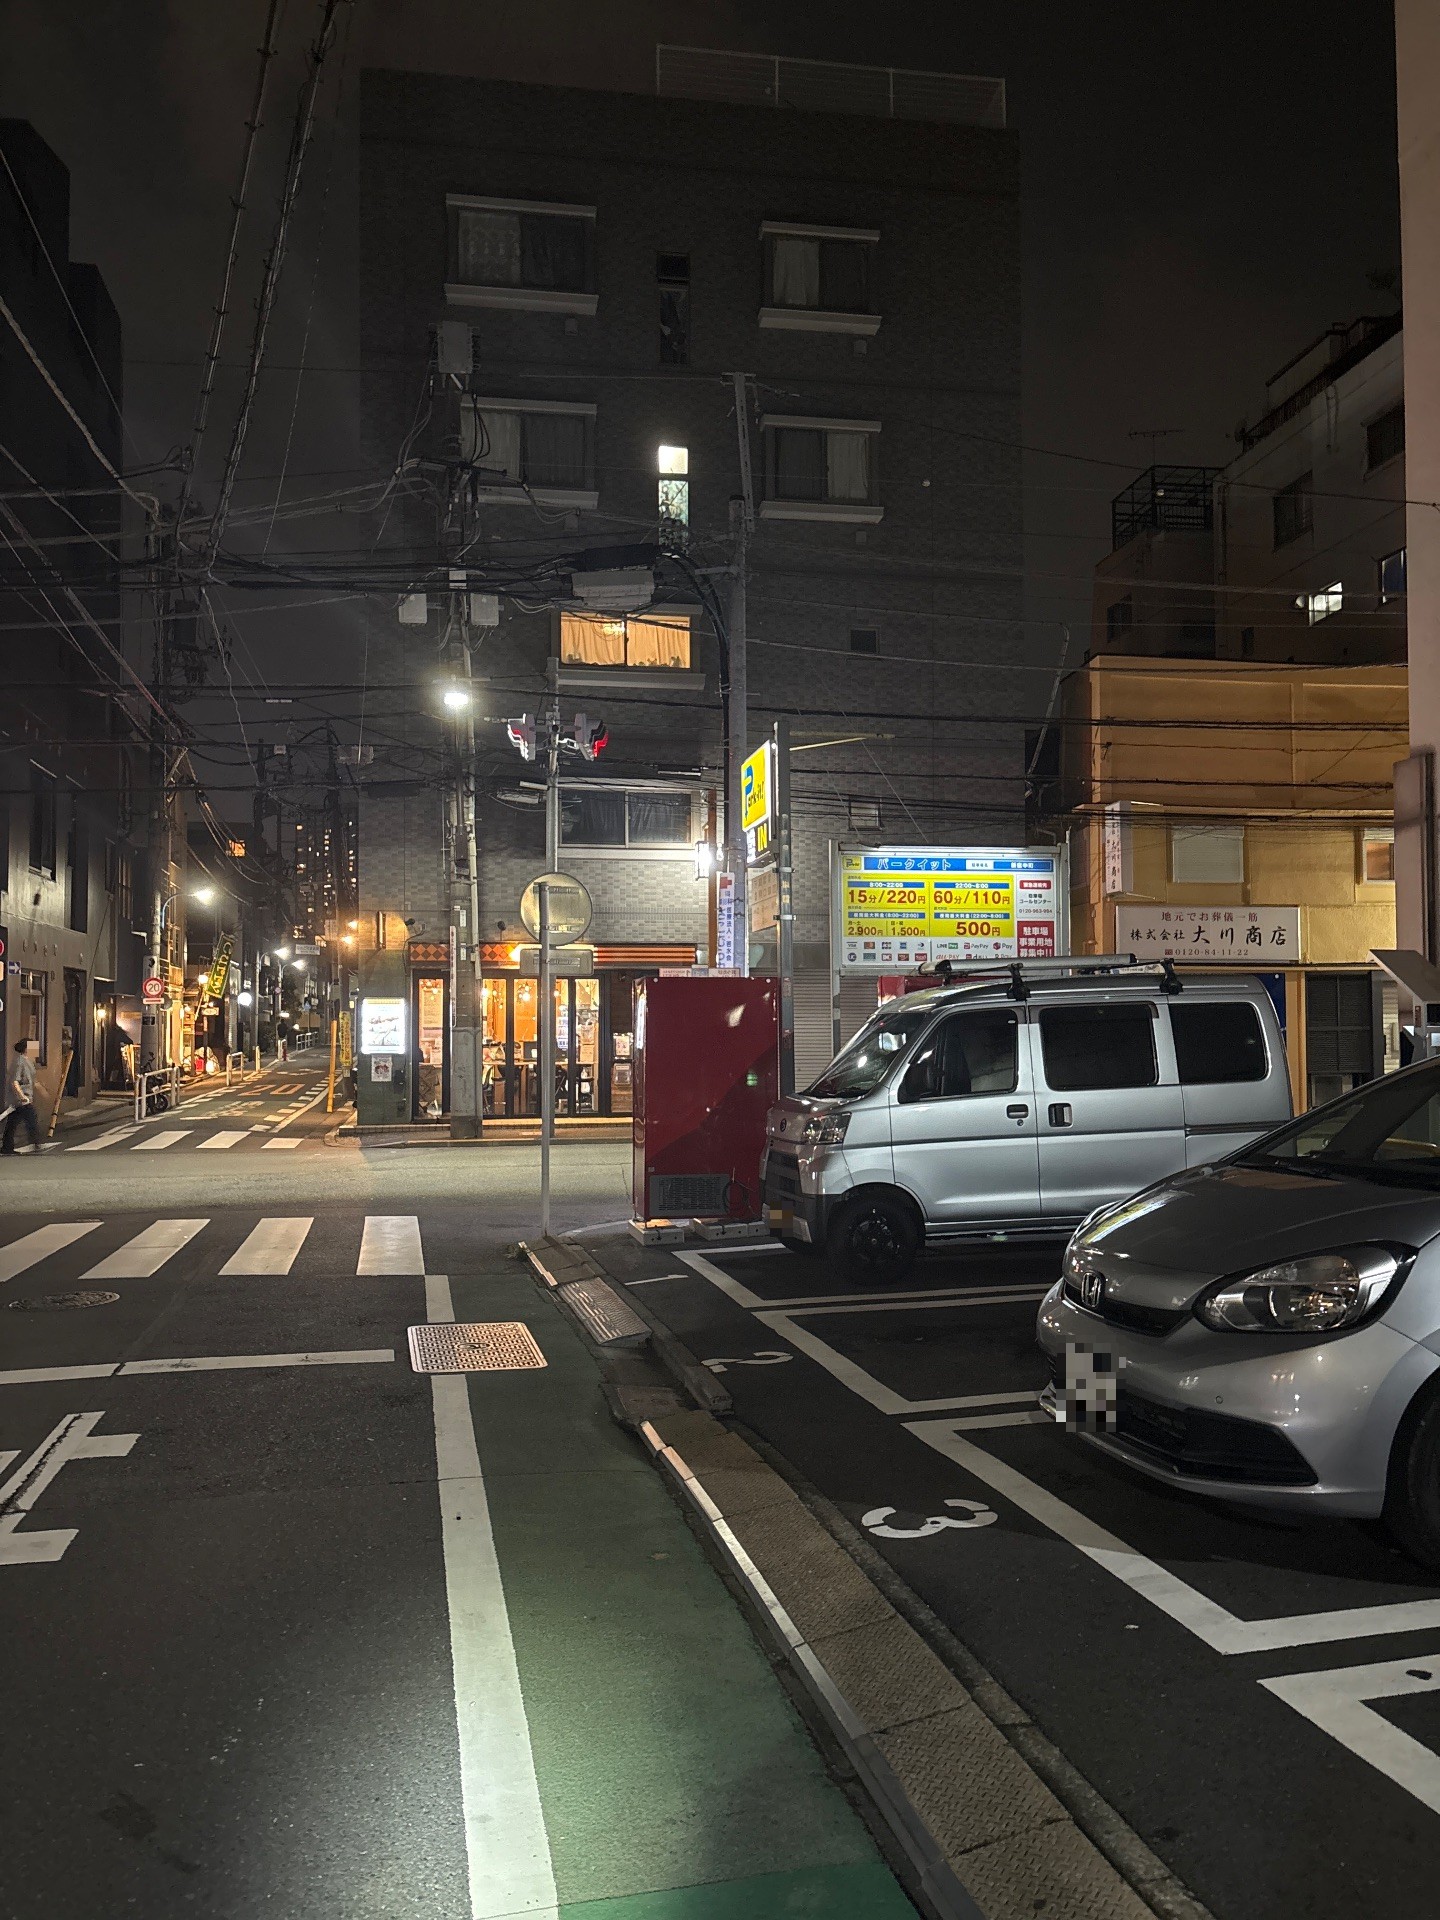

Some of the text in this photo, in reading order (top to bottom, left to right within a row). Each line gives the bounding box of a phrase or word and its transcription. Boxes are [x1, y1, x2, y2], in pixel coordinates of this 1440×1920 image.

[877, 858, 952, 871] パークイット
[1161, 911, 1259, 923] 地元でお葬儀一筋
[848, 926, 884, 936] 2,900円
[891, 927, 926, 936] 1,500円
[956, 922, 1001, 936] 500円
[1022, 926, 1049, 936] 駐車場
[1130, 925, 1288, 947] 株式会社 大川商店
[1018, 937, 1053, 947] 事業用地
[1174, 948, 1249, 956] 0120-84-11-22
[147, 983, 160, 993] 20
[238, 1083, 306, 1097] 20
[860, 1497, 999, 1540] 3
